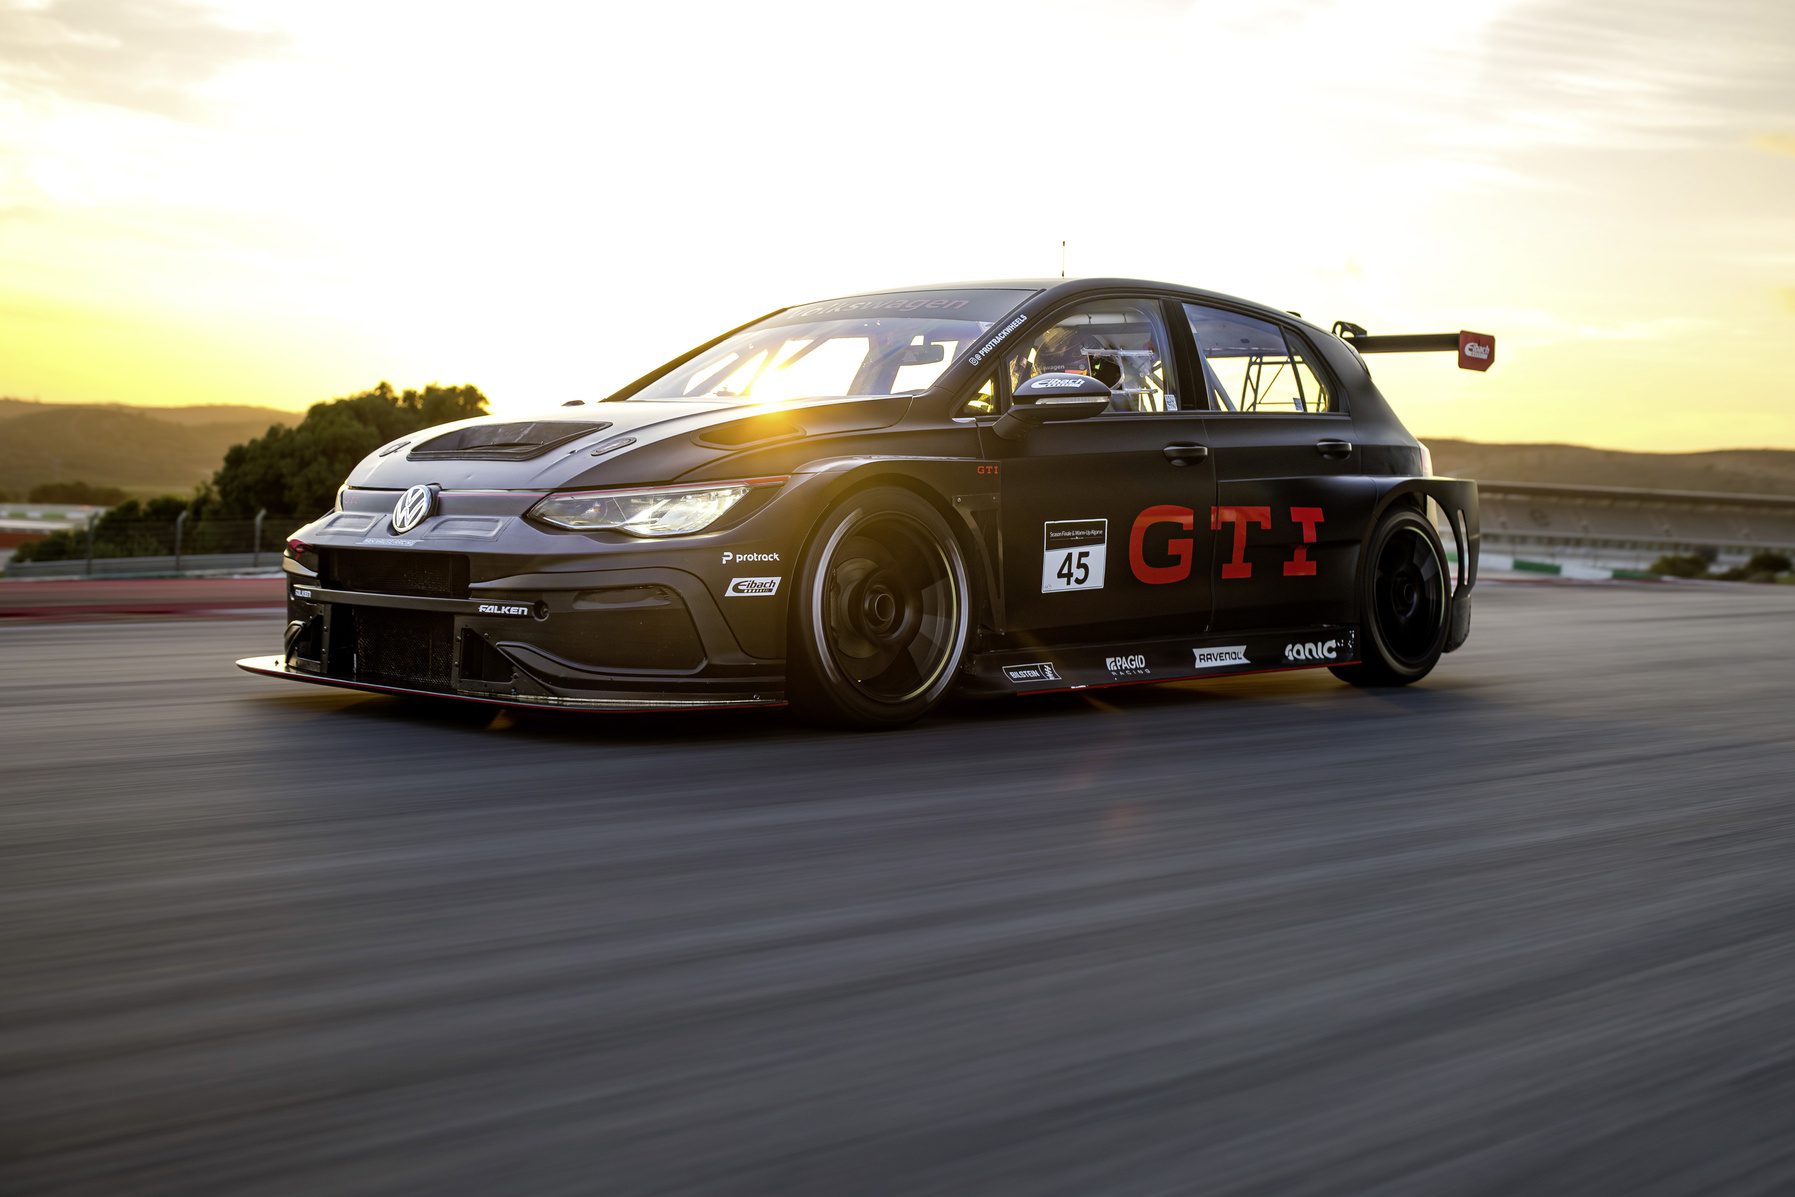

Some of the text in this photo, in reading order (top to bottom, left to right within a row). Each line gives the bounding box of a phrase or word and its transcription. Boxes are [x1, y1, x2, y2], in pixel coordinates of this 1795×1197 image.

[1031, 378, 1085, 389] Eibach
[977, 466, 999, 474] GTI
[1129, 505, 1325, 585] GTI
[736, 552, 780, 563] protrack
[1057, 551, 1090, 586] 45
[732, 580, 776, 593] Eibach
[478, 604, 528, 615] FALKEN
[1199, 651, 1243, 662] RAVENOL
[1116, 655, 1146, 670] PAGID
[1009, 669, 1040, 679] BILSTEIN
[1111, 668, 1151, 676] RACING
